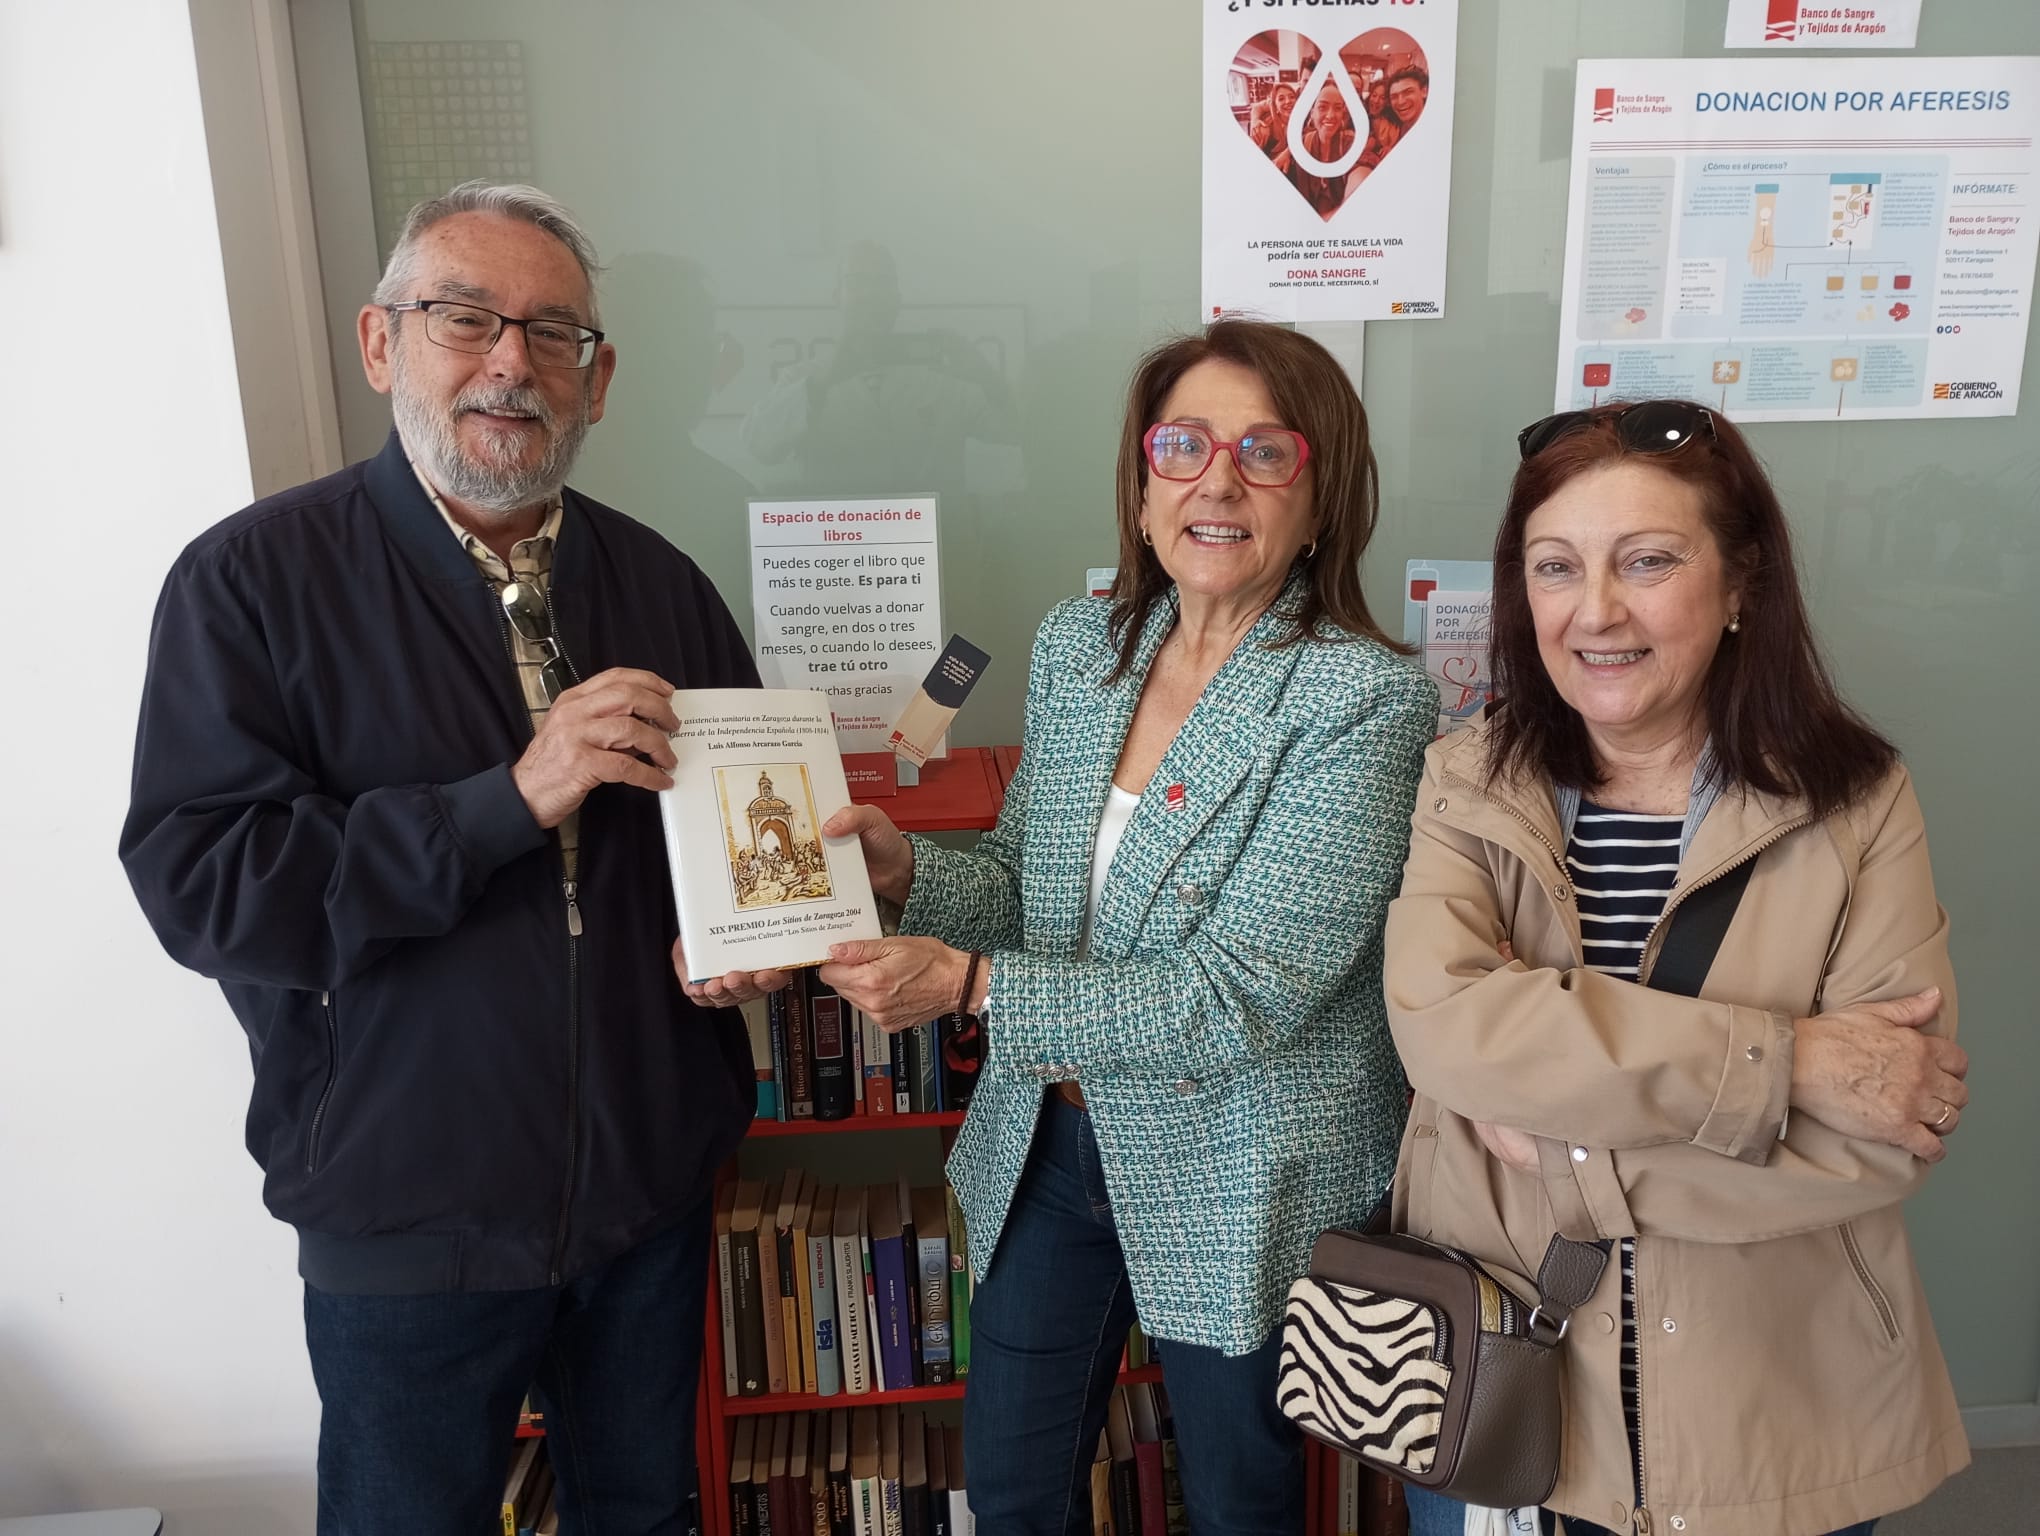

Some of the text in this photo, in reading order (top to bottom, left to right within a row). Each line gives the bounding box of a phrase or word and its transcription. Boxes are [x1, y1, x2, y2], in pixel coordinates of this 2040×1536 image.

[1800, 8, 1875, 20] Banco de Sangre
[1799, 22, 1886, 35] y Tejidos de Aragón
[1616, 95, 1665, 104] Banco de Sangre
[1695, 90, 2011, 113] DONACION POR AFERESIS
[1643, 105, 1651, 113] de
[1595, 167, 1630, 176] Ventajas
[1949, 215, 2020, 225] Banco de Sangre y
[1948, 228, 1975, 237] Tejidos
[1976, 227, 1986, 236] de
[1248, 238, 1404, 249] LA PERSONA QUE TE SALVE LA VIDA
[1267, 250, 1384, 262] podría ser CUALQUIERA
[1287, 268, 1366, 280] DONA SANGRE
[1950, 381, 1998, 392] GOBIERNO
[1949, 391, 1961, 400] DE
[762, 508, 921, 526] Espacio de donación de
[823, 528, 863, 541] libros
[763, 554, 925, 572] Puedes coger el libro que
[768, 573, 921, 590] más te guste. Es para ti
[770, 600, 925, 617] Cuando vuelvas a donar
[1436, 605, 1492, 615] DONACIO
[1435, 618, 1460, 627] POR
[781, 620, 915, 639] sangre, en dos o tres
[761, 639, 937, 658] meses, o cuando lo desees,
[808, 658, 888, 673] trae tú otro
[810, 683, 893, 698] chas gracias
[684, 715, 719, 725] asistencia
[721, 715, 750, 724] sanitaria
[698, 728, 706, 737] de
[708, 728, 715, 736] la
[717, 727, 765, 737] Independencia
[767, 727, 795, 736] Española
[708, 742, 724, 750] Luis
[725, 741, 751, 750] Alfonso
[708, 908, 862, 935] XIX PREMIO Los Sitios de Zaragoza 2004
[722, 934, 757, 945] Asociación
[758, 929, 783, 940] Cultural
[800, 924, 818, 934] Sitios
[818, 923, 826, 931] de
[791, 999, 806, 1097] Historia de Dos Castillos
[816, 1319, 833, 1351] isla
[862, 1488, 871, 1525] PRUEBA
[816, 1502, 827, 1526] POLO
